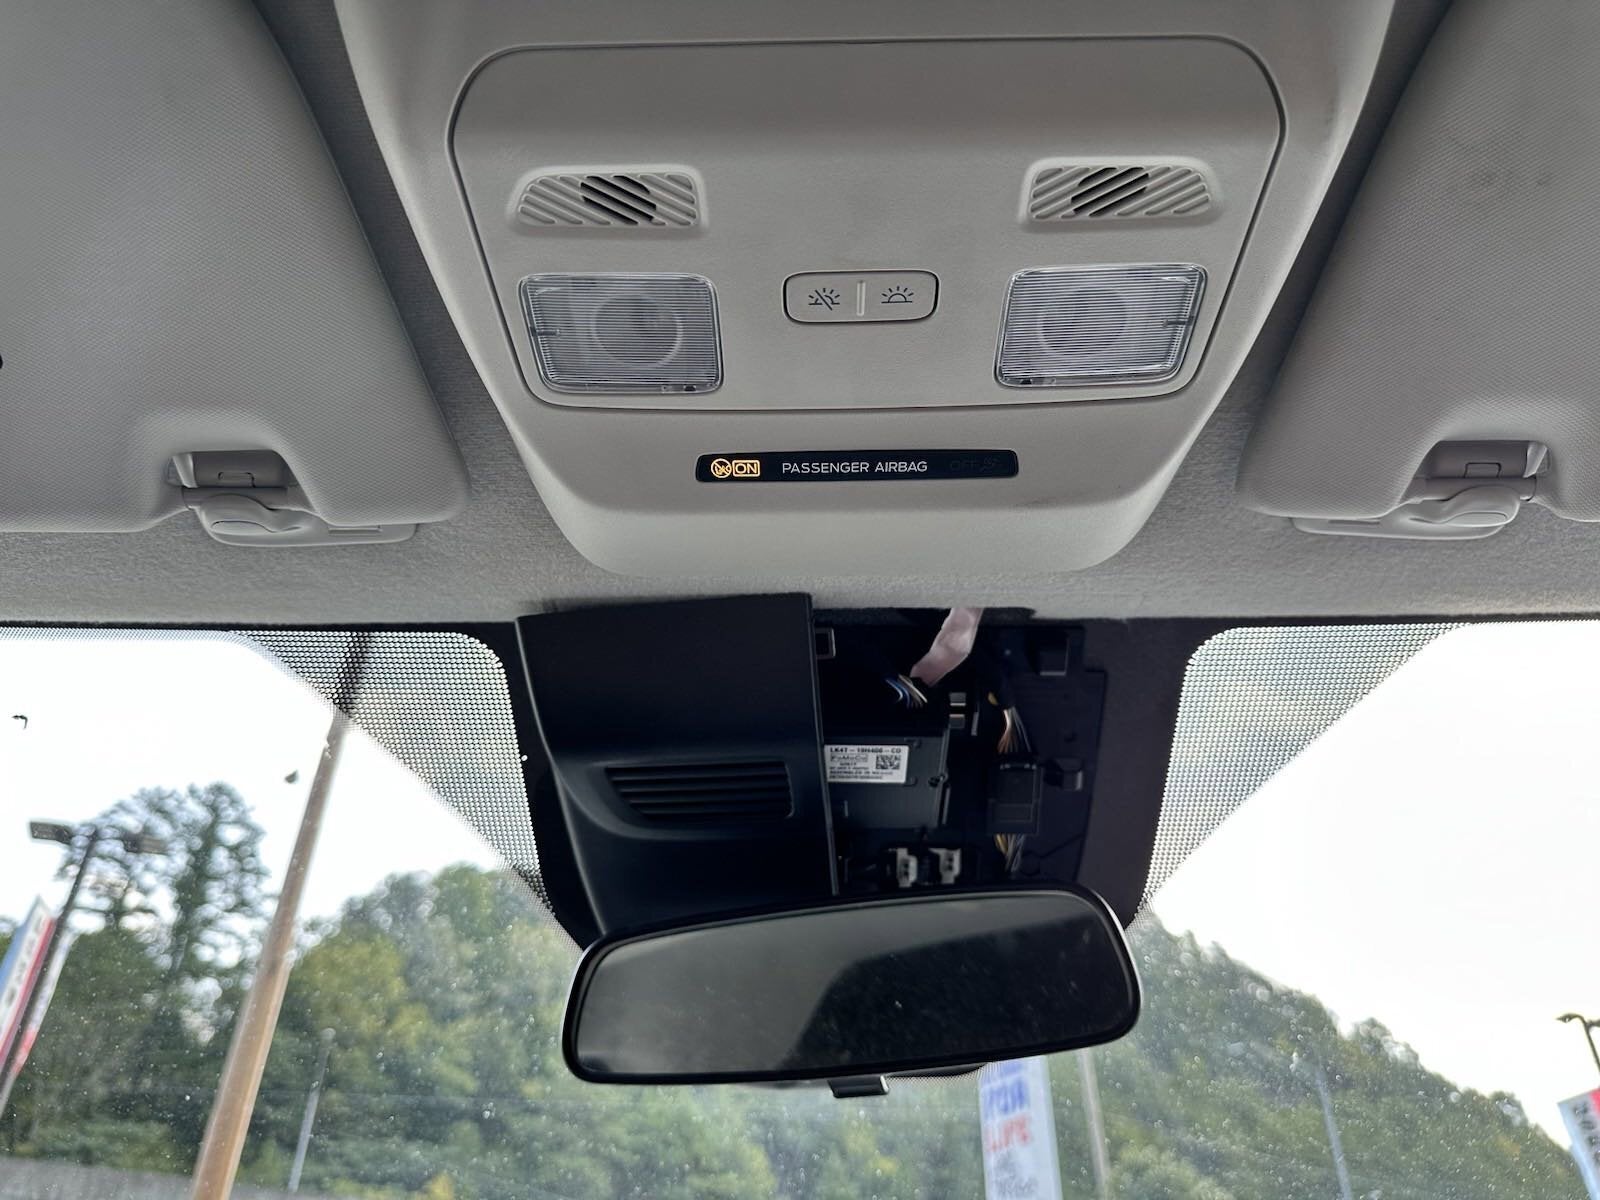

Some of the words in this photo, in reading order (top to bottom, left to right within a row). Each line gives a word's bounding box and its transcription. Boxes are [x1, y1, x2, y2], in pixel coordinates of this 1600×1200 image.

[735, 461, 757, 475] ON
[782, 462, 869, 474] PASSENGER
[875, 461, 928, 473] AIRBAG
